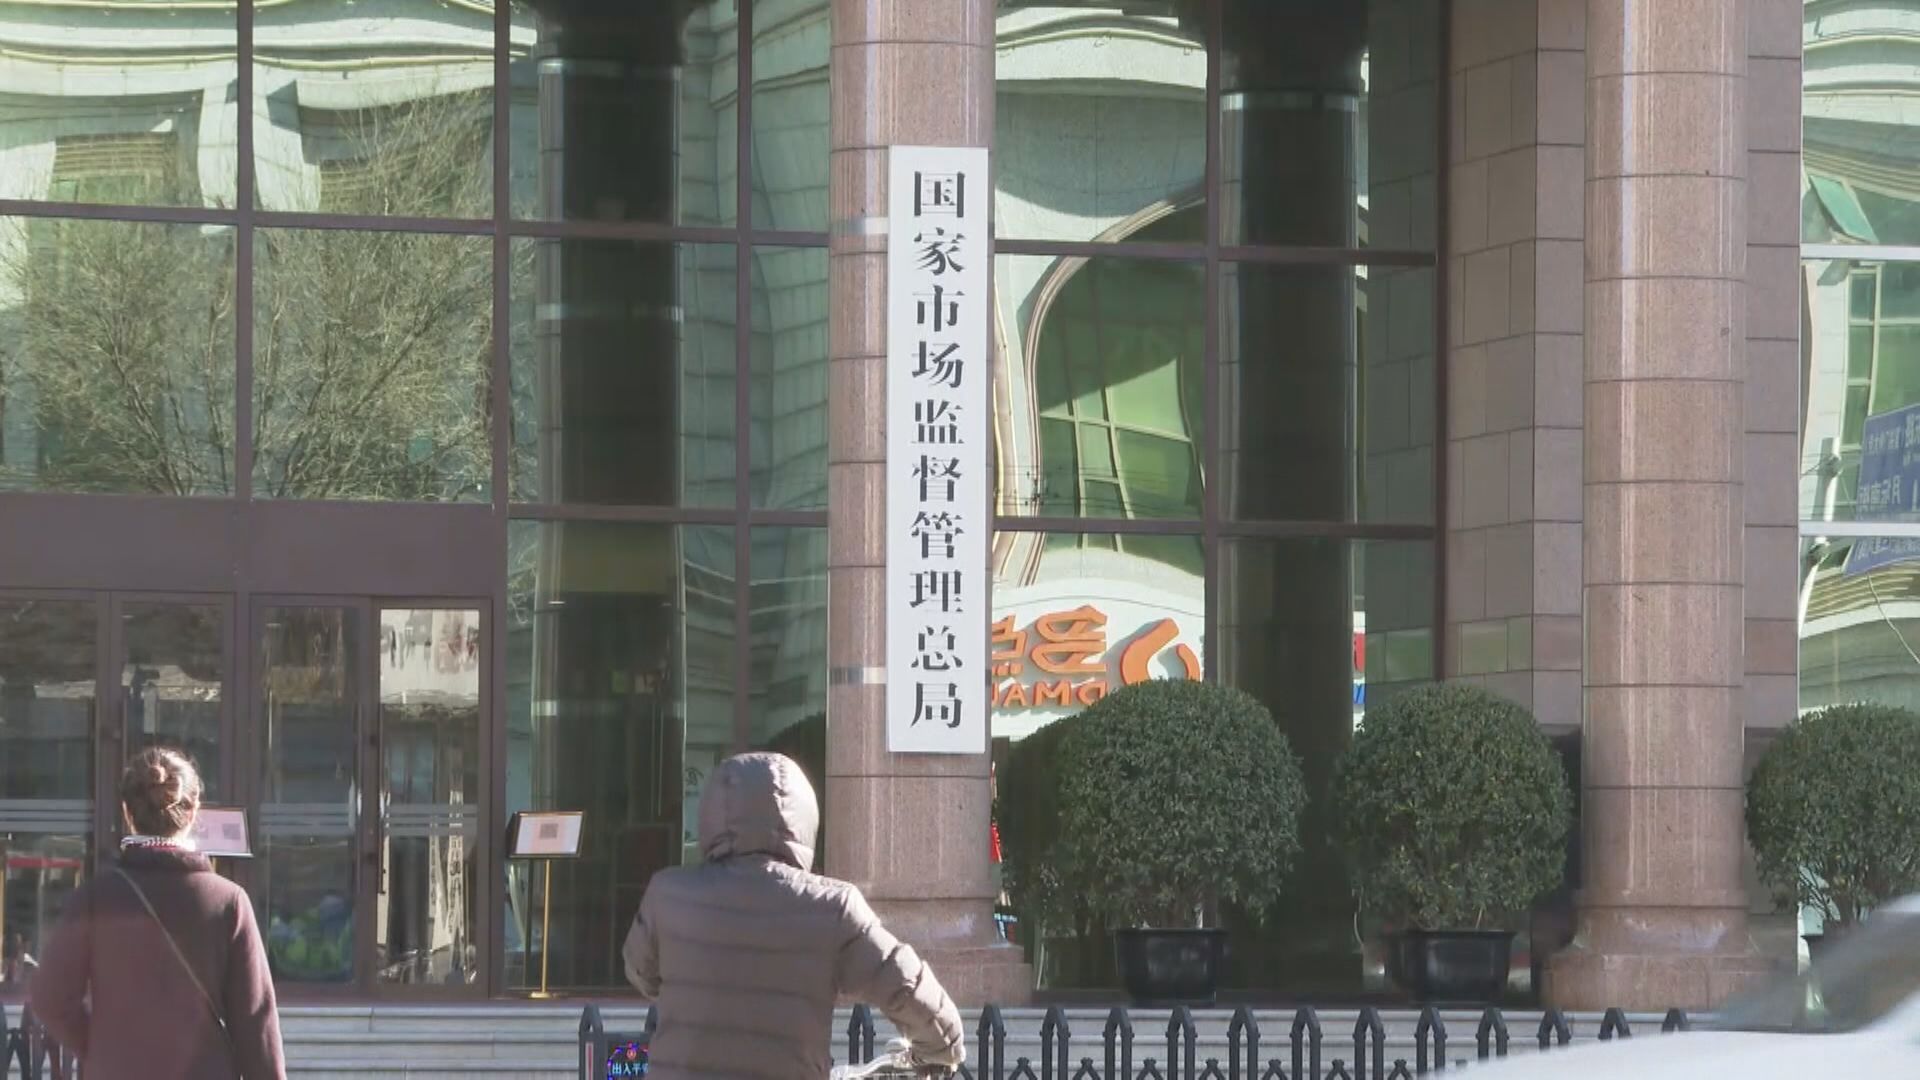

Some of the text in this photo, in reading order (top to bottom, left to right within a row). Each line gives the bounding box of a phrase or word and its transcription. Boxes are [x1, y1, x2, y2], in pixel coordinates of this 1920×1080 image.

[909, 170, 966, 729] 国家市场监督管理总局
